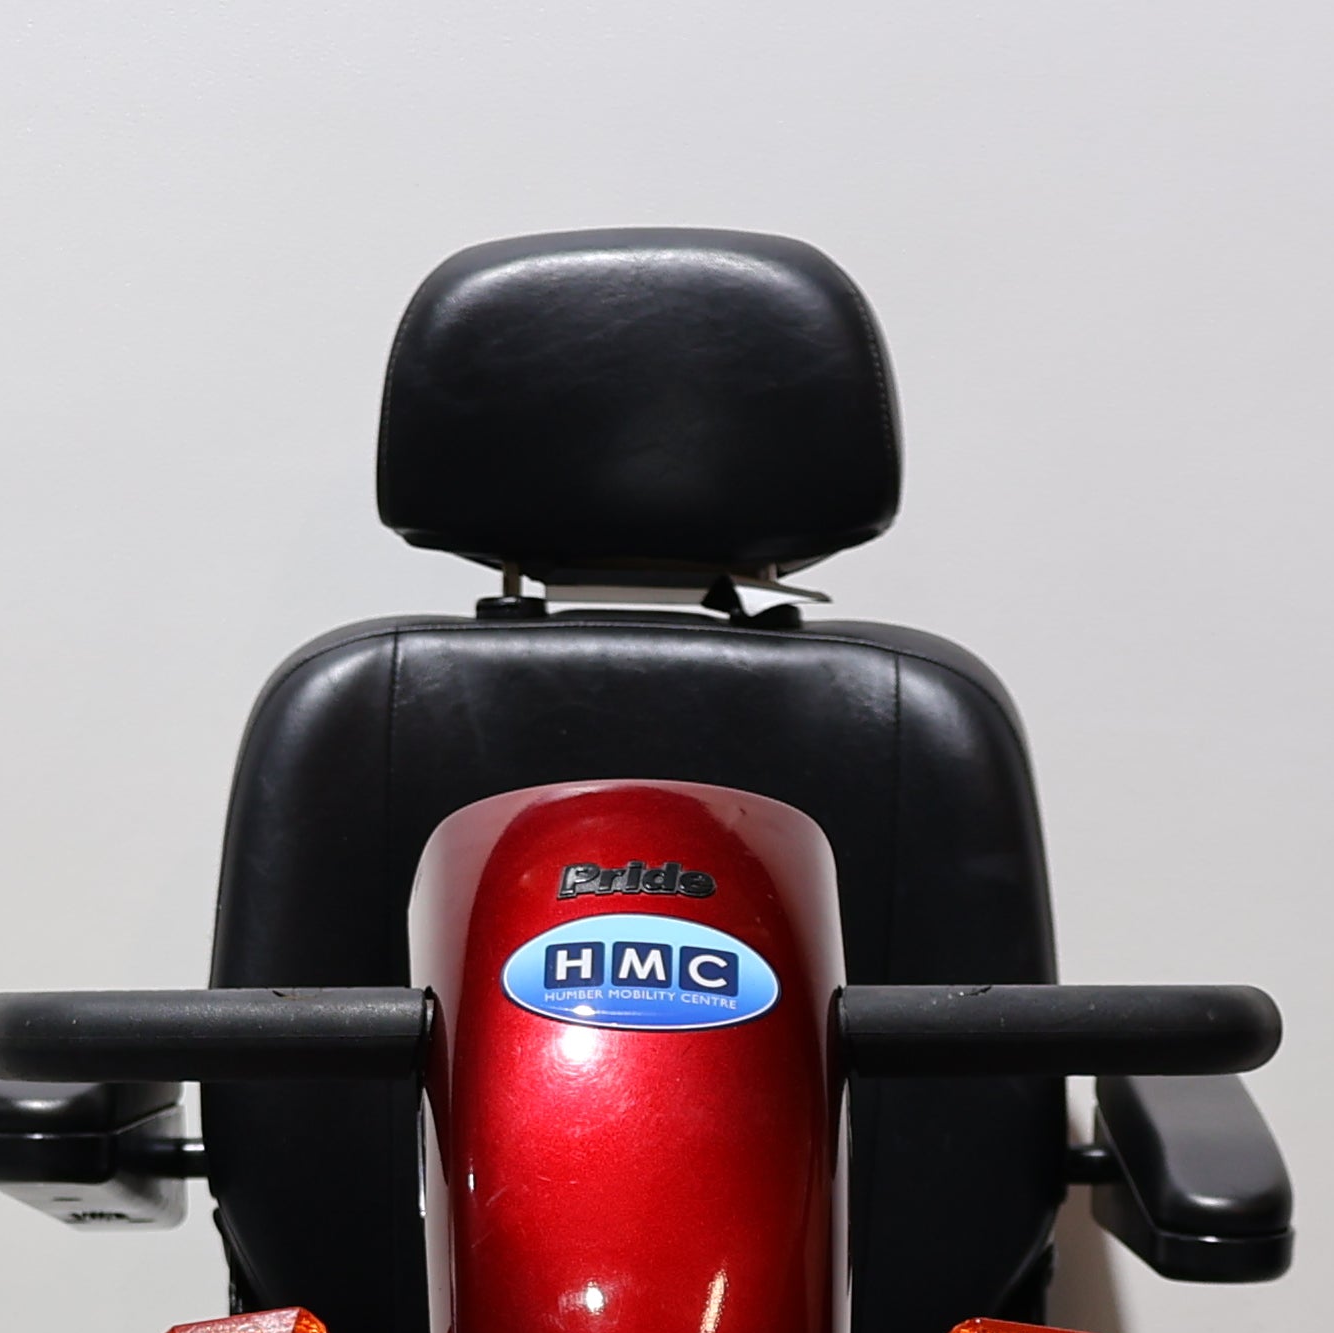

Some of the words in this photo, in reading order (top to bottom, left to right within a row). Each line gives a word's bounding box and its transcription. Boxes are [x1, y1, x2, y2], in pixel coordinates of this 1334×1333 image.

[557, 861, 717, 899] Pride
[556, 948, 728, 988] HMC
[544, 989, 603, 1002] HUMBER
[608, 989, 676, 1002] MOBILITY
[681, 993, 737, 1010] CENTRE
